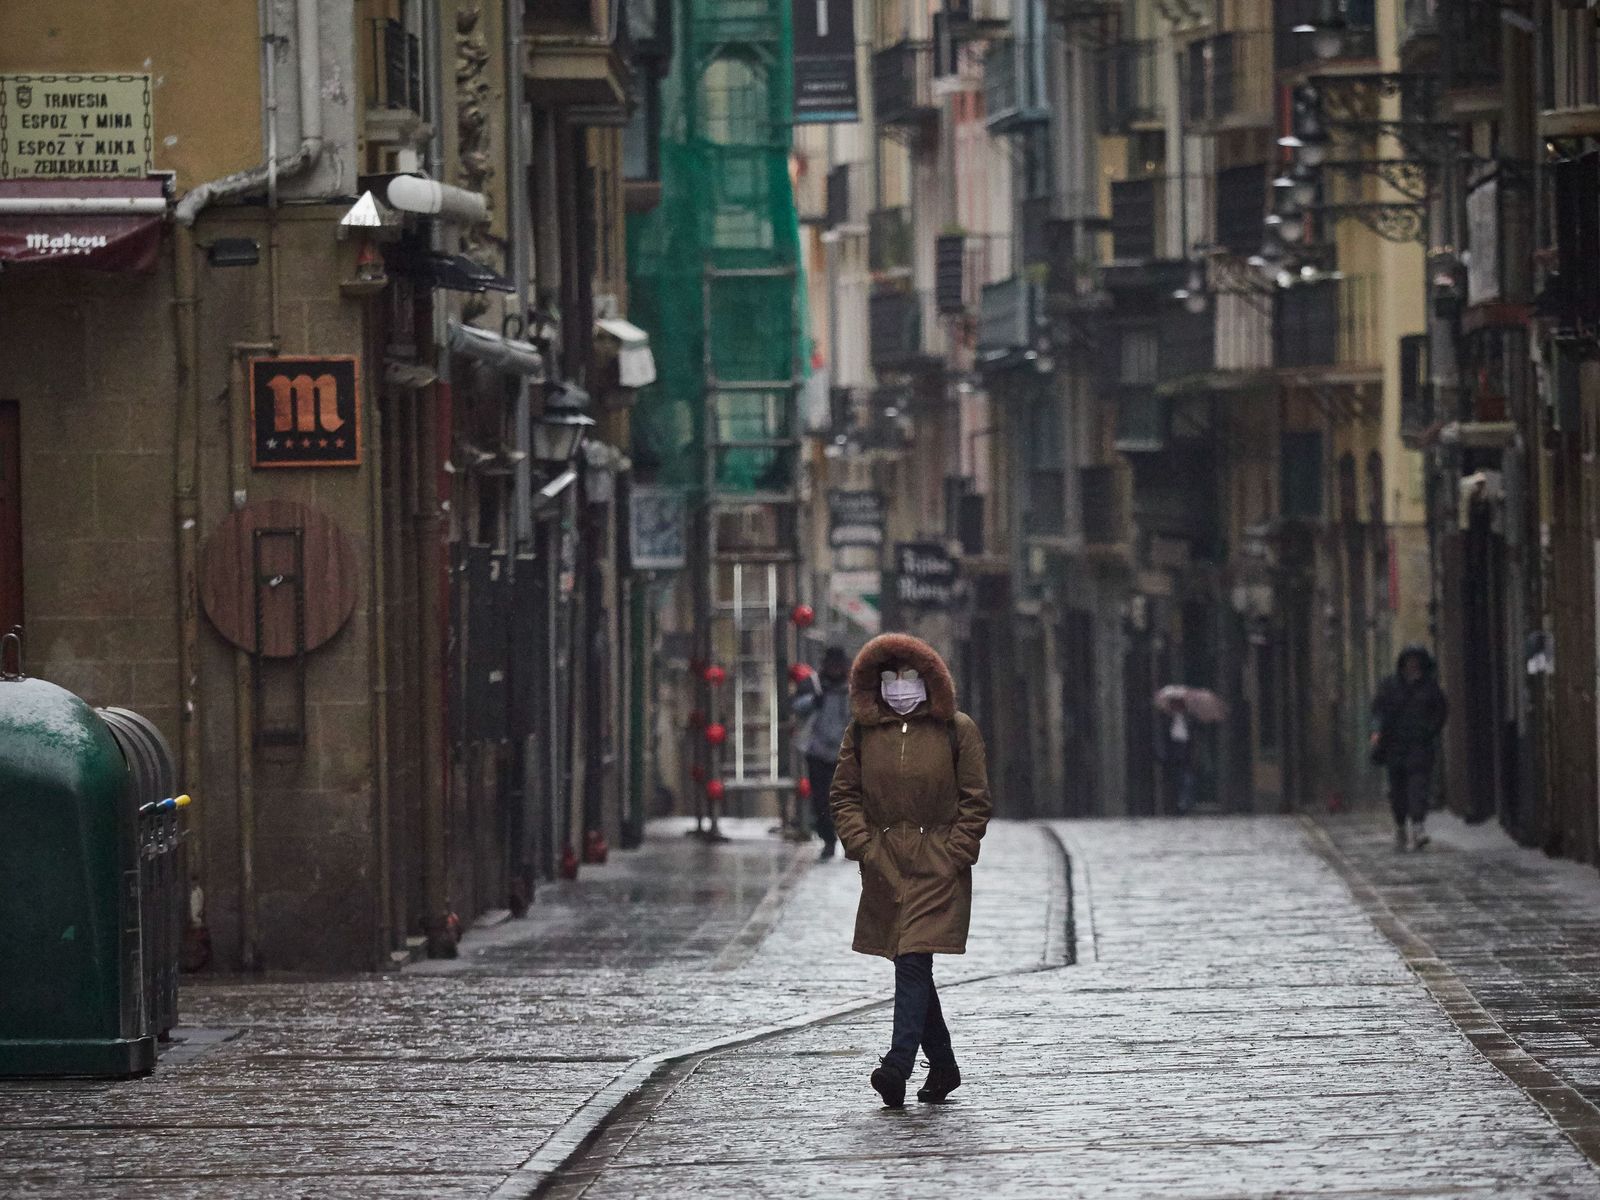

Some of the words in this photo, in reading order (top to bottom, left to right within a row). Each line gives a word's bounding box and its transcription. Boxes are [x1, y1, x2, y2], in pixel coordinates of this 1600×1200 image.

[44, 93, 108, 108] TRAVESIA
[22, 114, 68, 129] ESPOZ
[81, 114, 89, 129] Y
[97, 113, 133, 129] MINA
[18, 140, 66, 155] ESPOZ
[75, 140, 85, 155] Y
[95, 140, 136, 155] MINA
[26, 233, 108, 249] Mahou
